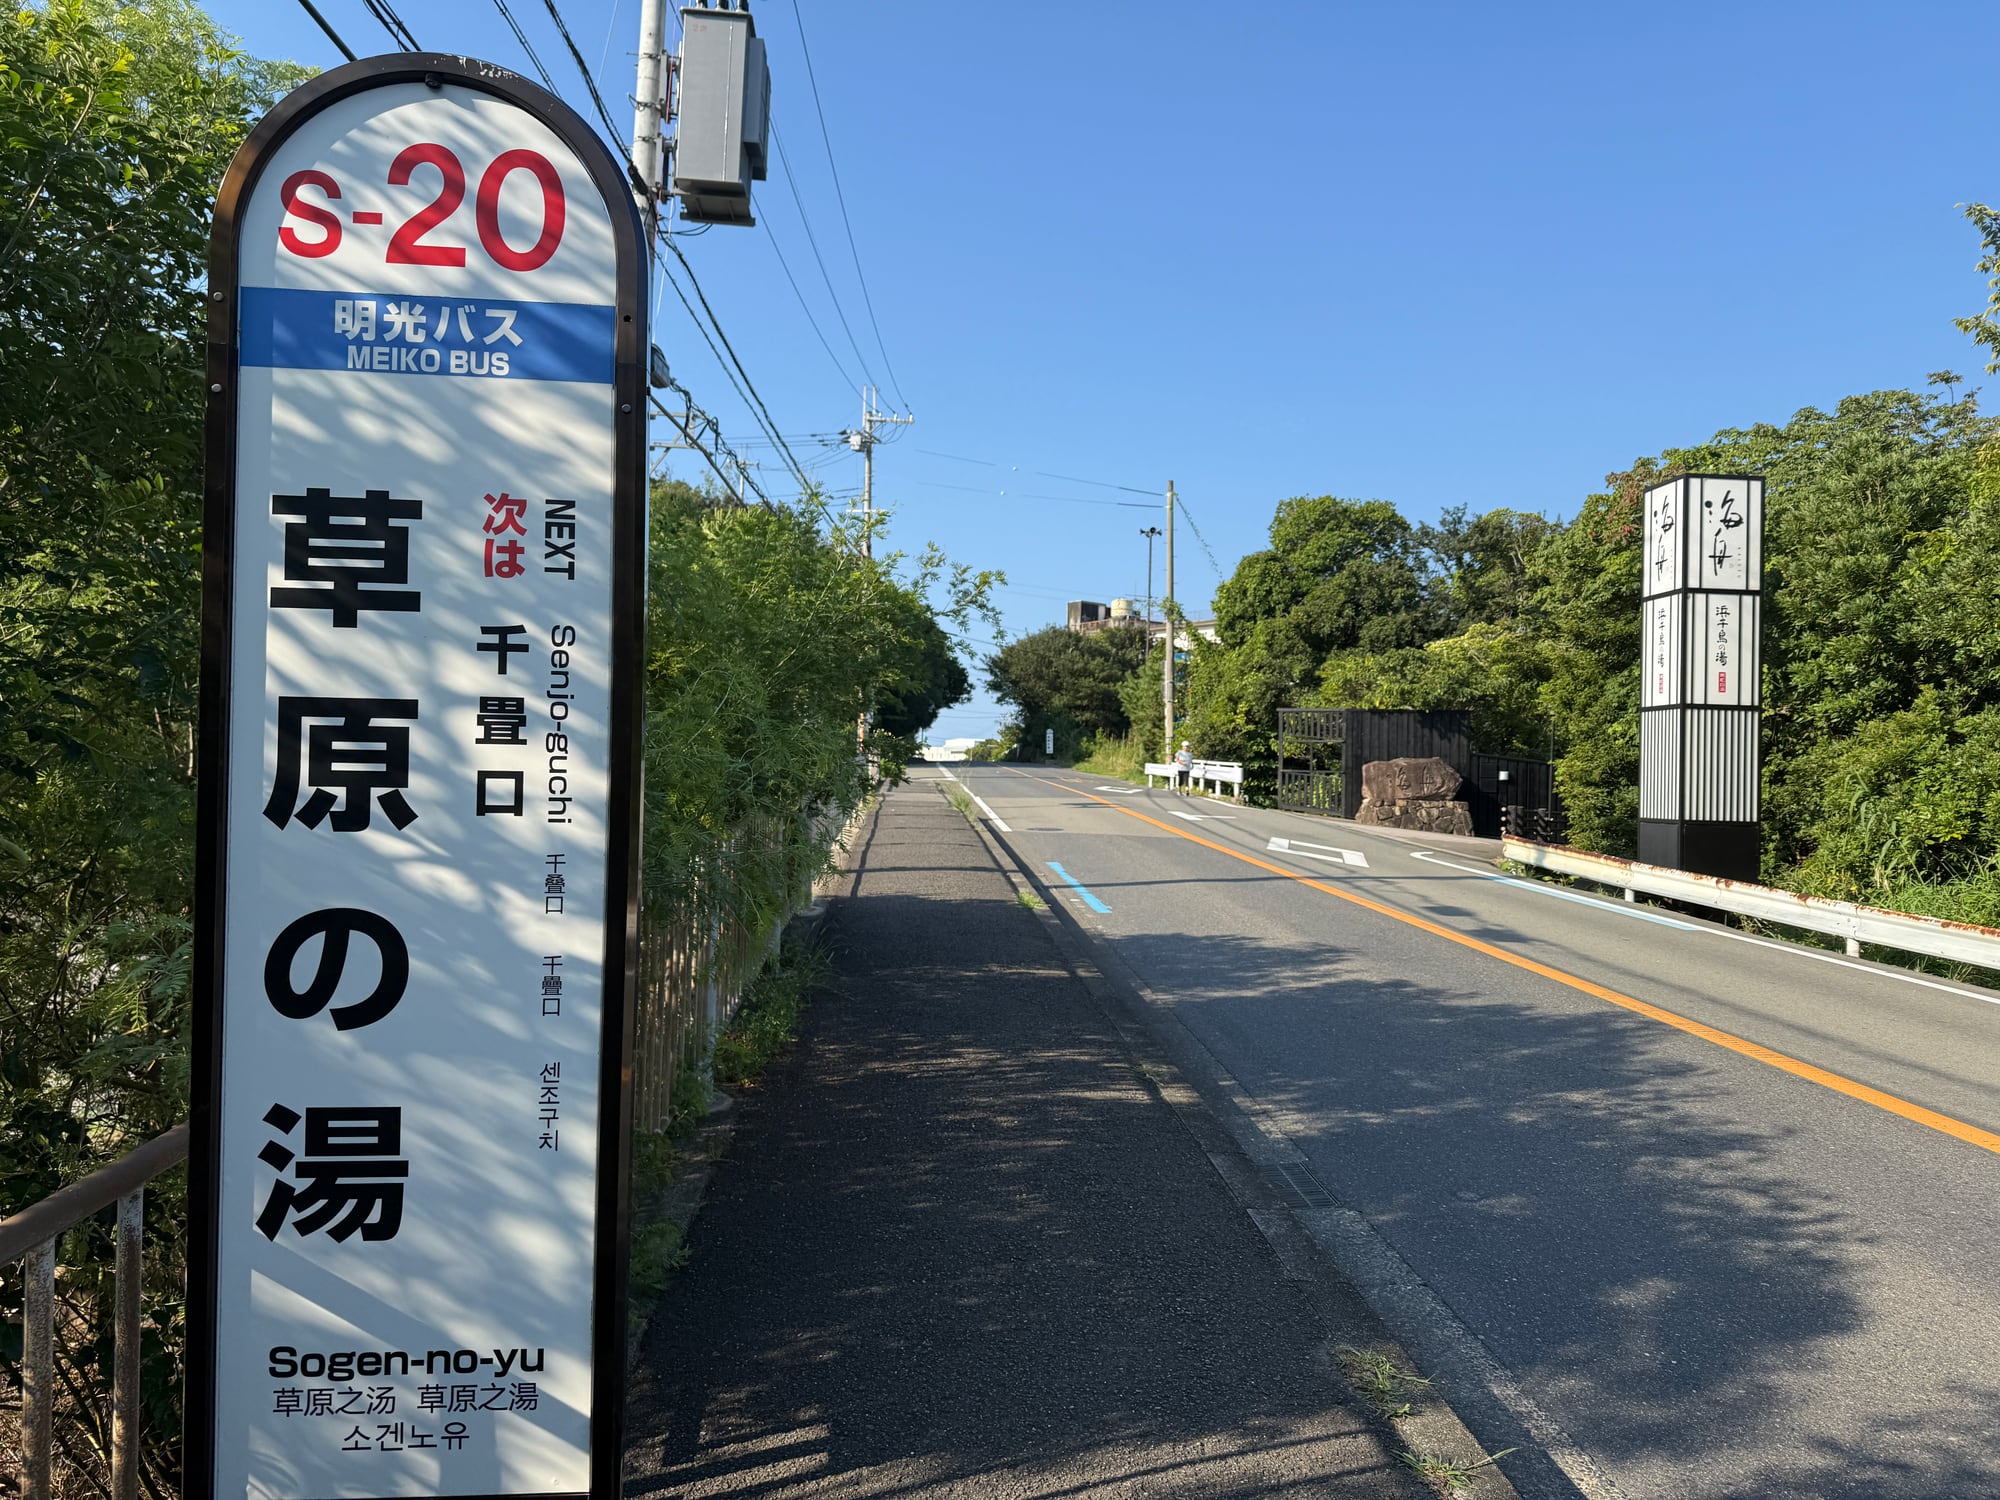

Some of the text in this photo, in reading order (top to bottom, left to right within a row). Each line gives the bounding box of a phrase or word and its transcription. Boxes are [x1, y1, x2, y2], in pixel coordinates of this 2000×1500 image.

[278, 142, 566, 272] S-20
[333, 299, 523, 347] 明光バス
[346, 346, 510, 376] MEIKO BUS
[482, 492, 528, 578] 次は
[544, 498, 576, 581] NEXT
[475, 624, 530, 817] 千畳口
[545, 624, 576, 824] Senjo-guchi
[255, 487, 423, 1244] 草原の湯
[538, 1060, 561, 1152] 센조구치
[268, 1346, 545, 1381] Sogen-no-yu
[272, 1382, 540, 1418] 草原之汤 草原之湯
[341, 1421, 470, 1452] 소겐노유
